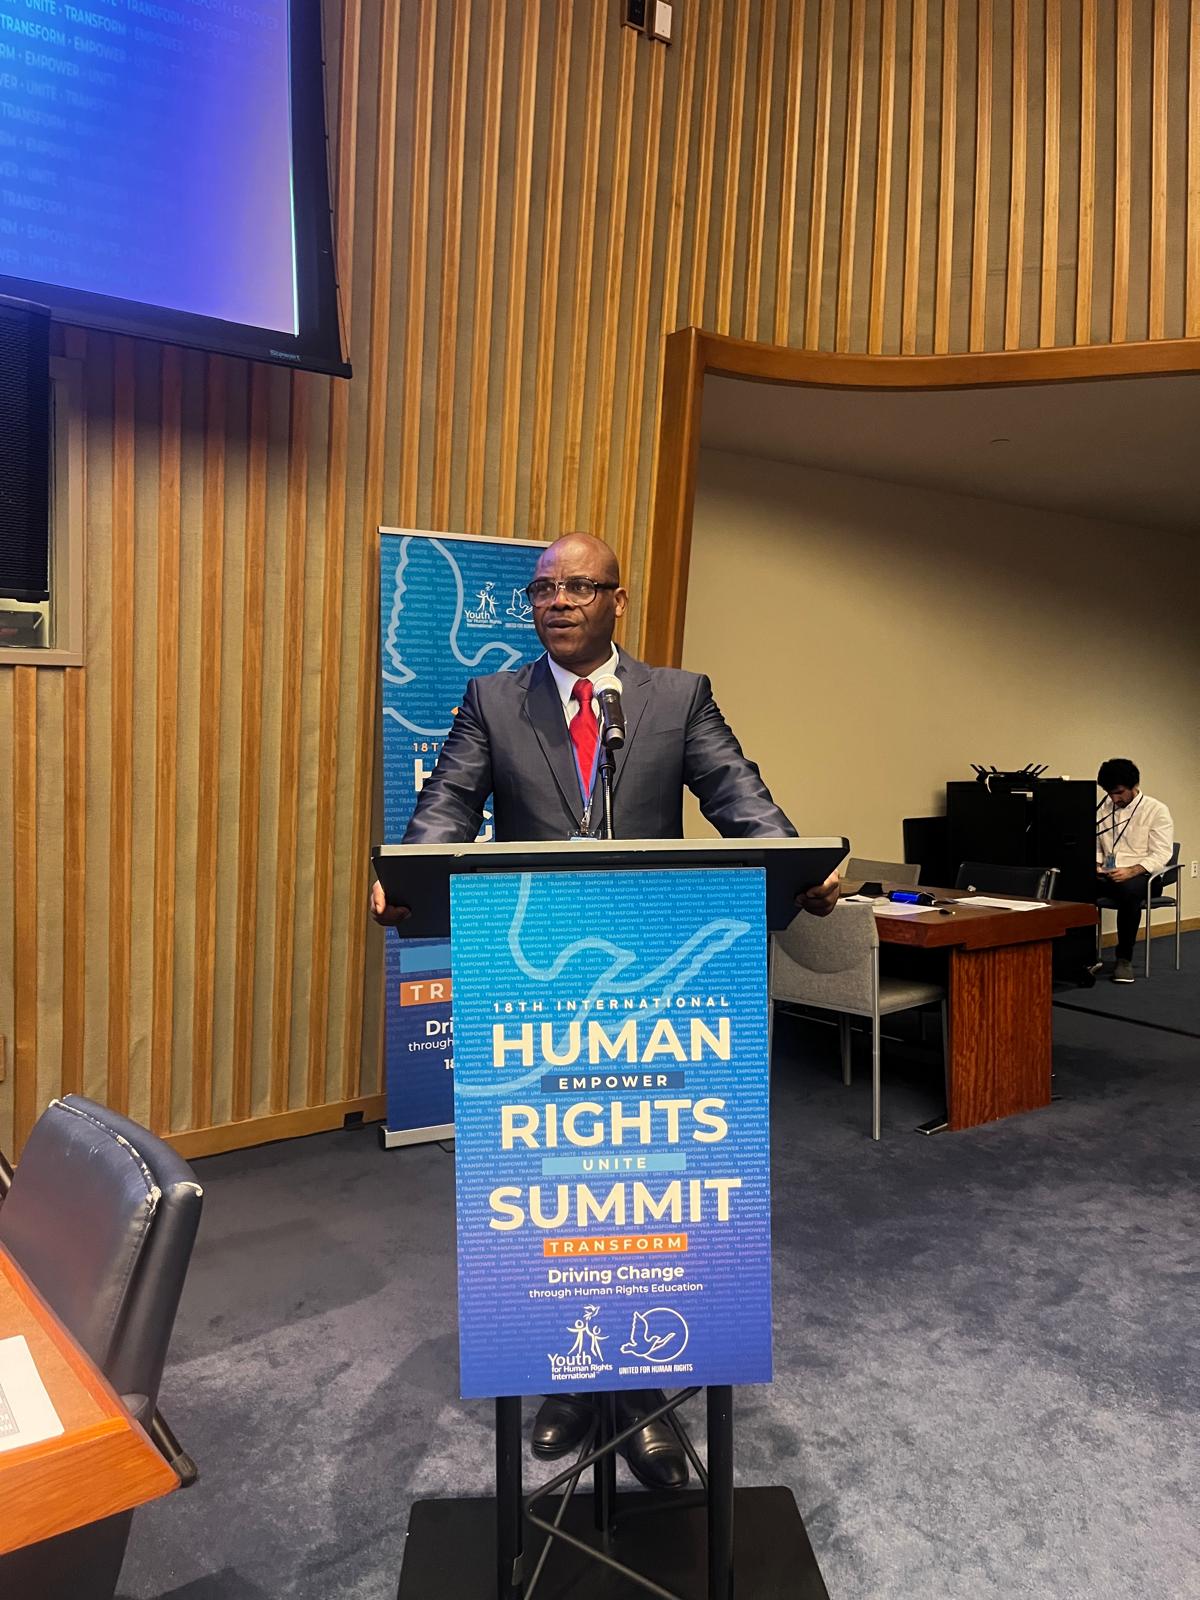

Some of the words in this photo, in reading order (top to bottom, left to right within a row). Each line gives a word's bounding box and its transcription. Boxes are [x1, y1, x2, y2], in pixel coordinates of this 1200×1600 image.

[64, 4, 126, 35] TRANSFORM
[0, 13, 66, 47] TRANSFORM
[74, 36, 128, 64] EMPOWER
[25, 50, 80, 78] EMPOWER
[464, 610, 490, 620] Youth
[414, 742, 444, 752] 18T
[494, 1002, 543, 1013] 18TH
[557, 996, 729, 1010] INTERNATIONAL
[493, 1018, 730, 1067] HUMAN
[559, 1074, 668, 1090] EMPOWER
[501, 1098, 729, 1150] RIGHTS
[582, 1157, 647, 1171] UNITE
[489, 1178, 742, 1230] SUMMIT
[550, 1237, 681, 1253] TRANSFORM
[548, 1266, 612, 1284] Driving
[617, 1266, 685, 1282] Change
[528, 1288, 572, 1299] through
[574, 1287, 612, 1296] Human
[616, 1284, 648, 1296] Rights
[652, 1282, 704, 1293] Education
[548, 1352, 592, 1368] Youth
[563, 1364, 588, 1372] Human
[590, 1362, 613, 1373] Rights
[618, 1366, 639, 1375] UNITED
[640, 1366, 650, 1374] FOR
[652, 1364, 672, 1373] HUMAN
[674, 1364, 694, 1372] RIGHTS
